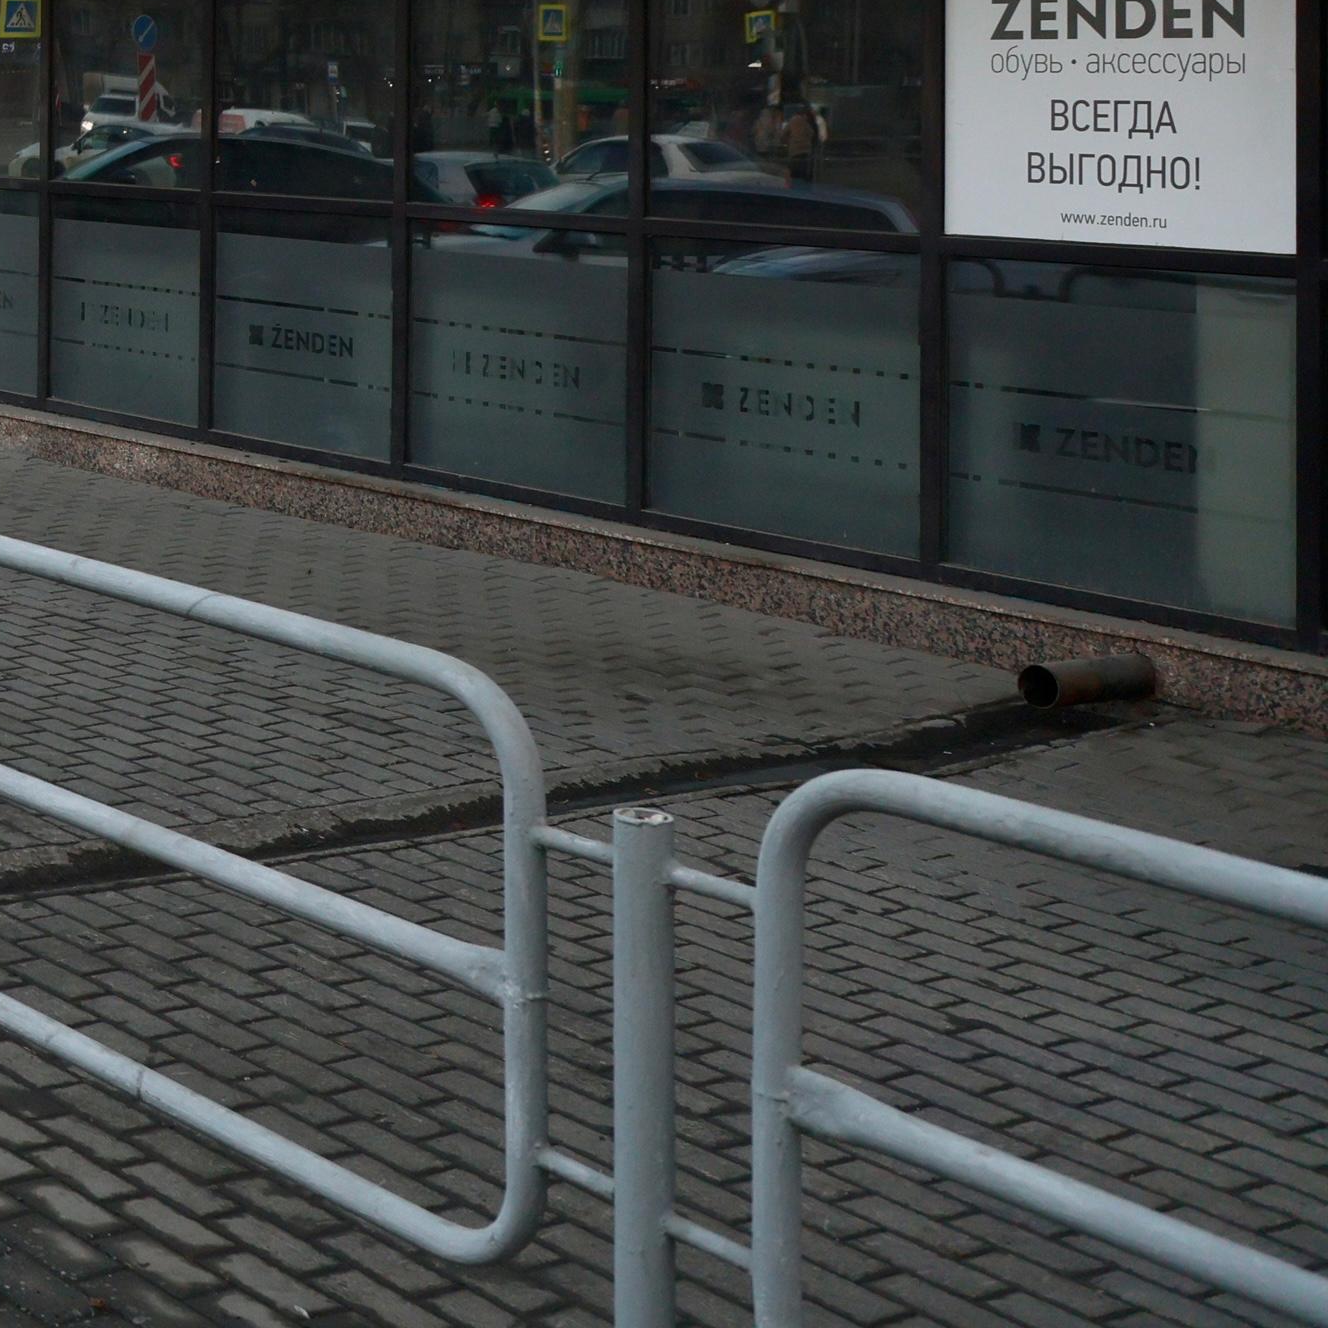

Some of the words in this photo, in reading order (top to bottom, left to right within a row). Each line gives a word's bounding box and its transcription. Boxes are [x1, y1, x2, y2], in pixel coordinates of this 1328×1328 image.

[991, 45, 1064, 81] обувь
[1085, 51, 1246, 82] аксессуары
[1050, 99, 1178, 140] ВСЕГДА
[1027, 151, 1201, 194] ВЫГОДНО!
[1060, 212, 1168, 229] www.zenden.ru
[271, 325, 355, 358] ZENDEN
